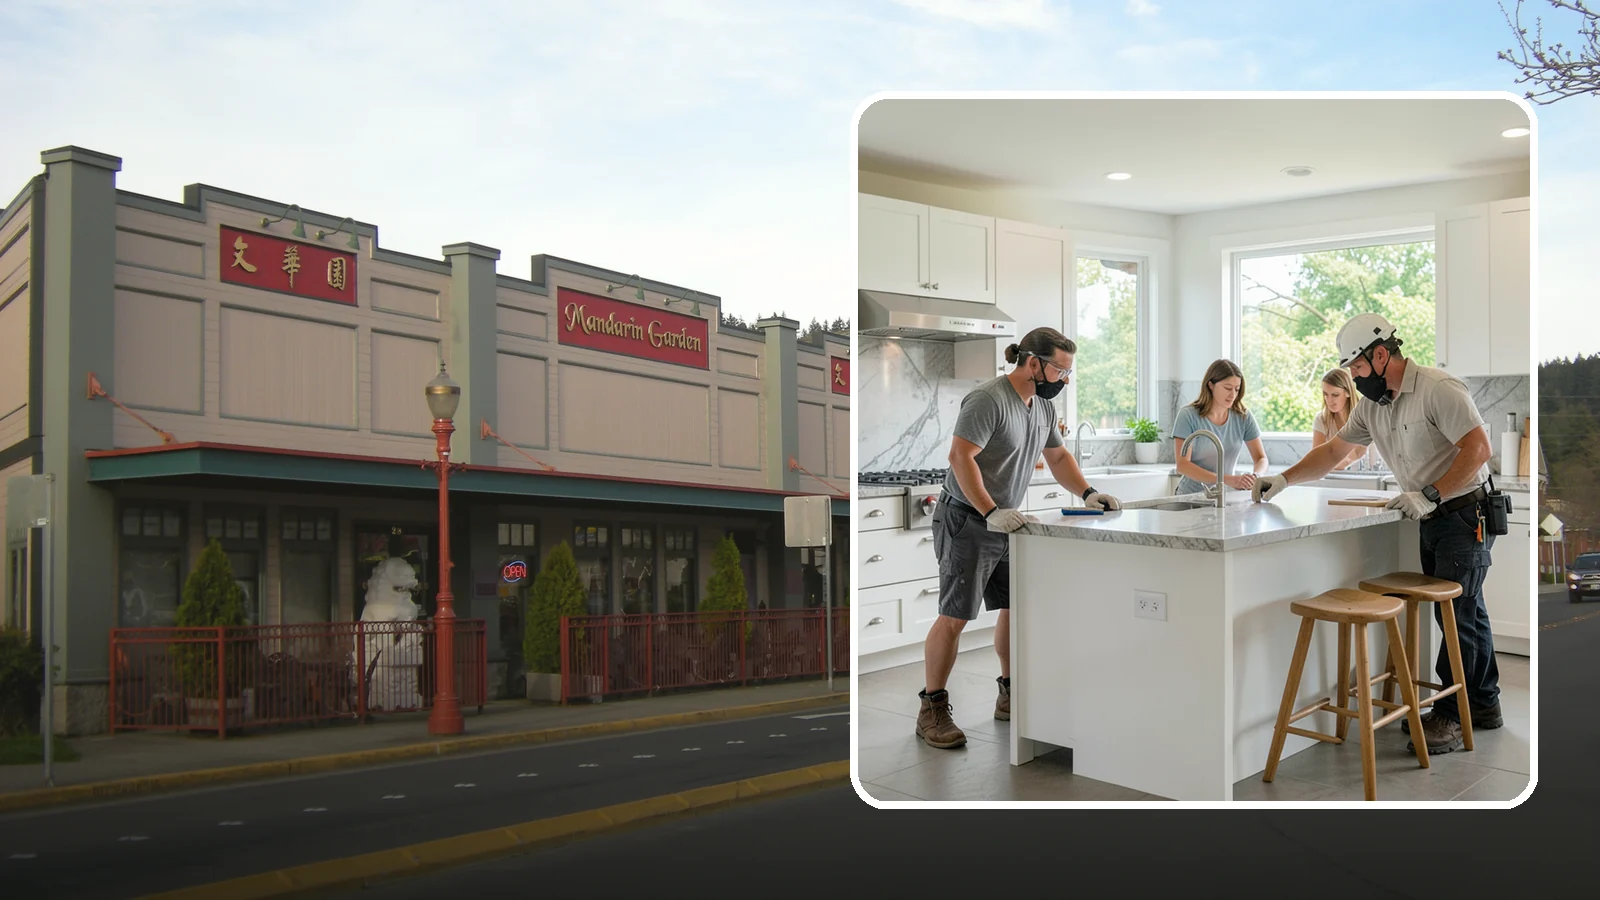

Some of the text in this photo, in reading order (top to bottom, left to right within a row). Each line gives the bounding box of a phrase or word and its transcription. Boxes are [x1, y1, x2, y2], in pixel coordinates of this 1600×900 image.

[231, 236, 346, 290] 文華園
[564, 302, 701, 352] Mandarin Garden
[503, 565, 527, 578] OPEN
